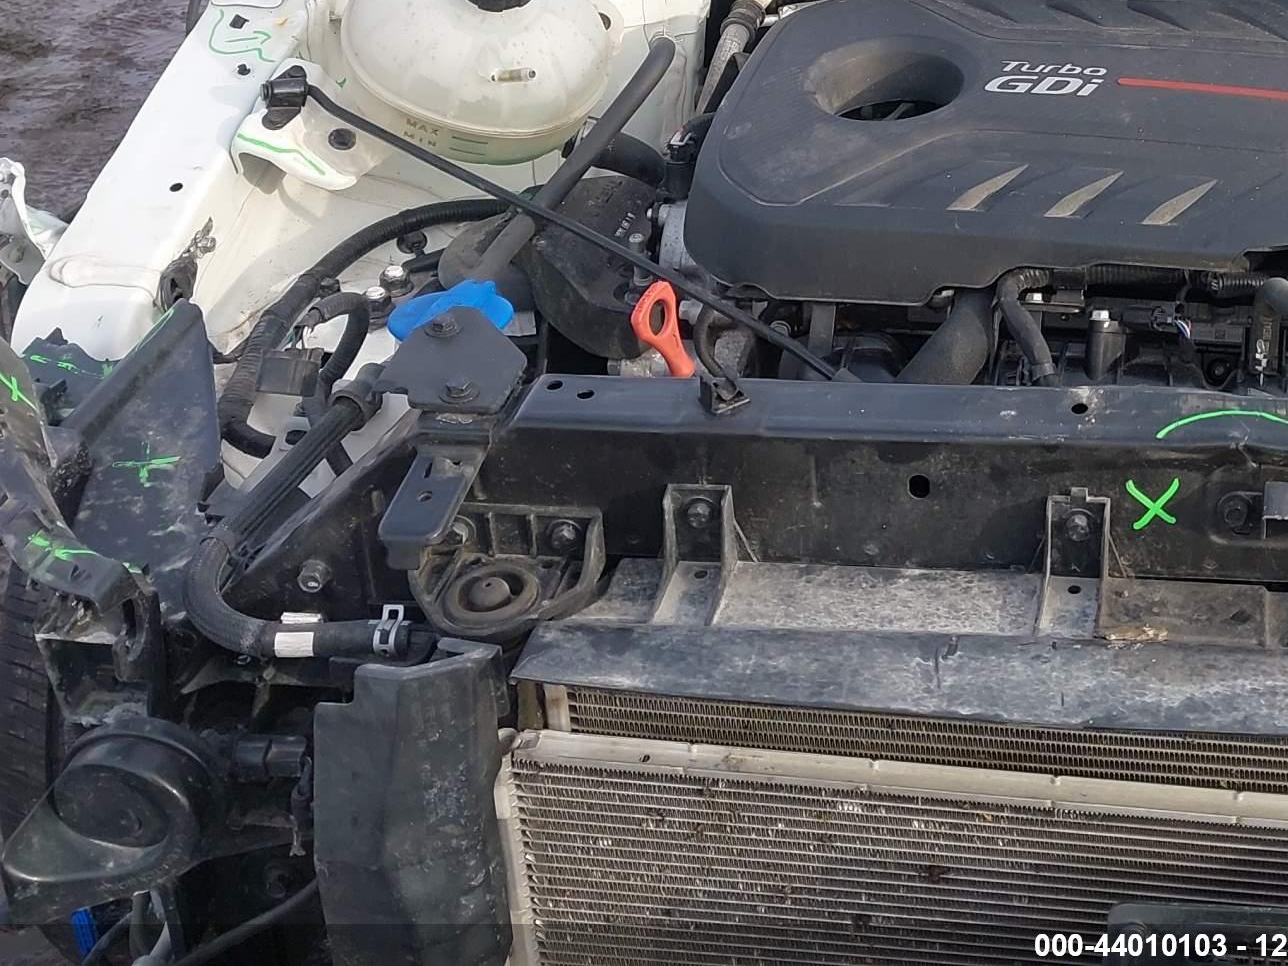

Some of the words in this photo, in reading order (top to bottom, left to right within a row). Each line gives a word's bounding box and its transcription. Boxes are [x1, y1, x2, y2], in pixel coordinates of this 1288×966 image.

[1001, 60, 1107, 76] Turbo
[984, 75, 1105, 96] GDi
[406, 117, 439, 136] MAX
[404, 130, 437, 147] MIN
